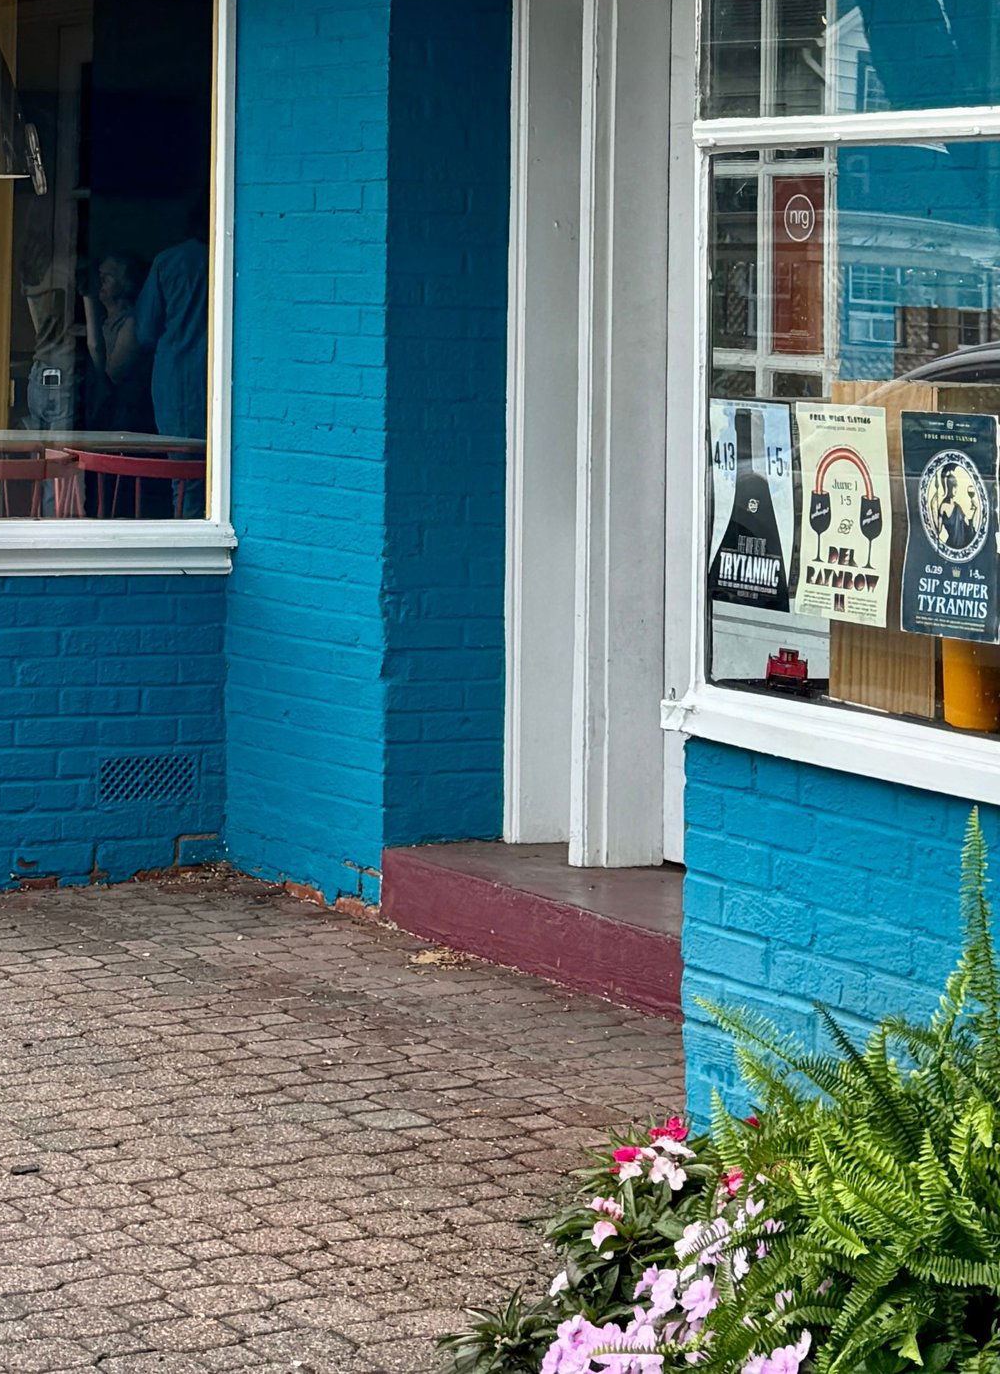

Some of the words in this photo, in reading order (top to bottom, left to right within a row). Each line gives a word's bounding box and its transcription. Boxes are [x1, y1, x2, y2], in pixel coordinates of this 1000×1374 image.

[790, 210, 809, 229] nrg
[831, 477, 853, 491] June
[828, 546, 858, 568] DEL
[719, 551, 780, 588] TRYTANNIC
[806, 565, 880, 593] RAYNBOW
[918, 577, 940, 593] SIP
[942, 580, 989, 600] SEMPER
[917, 594, 988, 619] TYRANNIS
